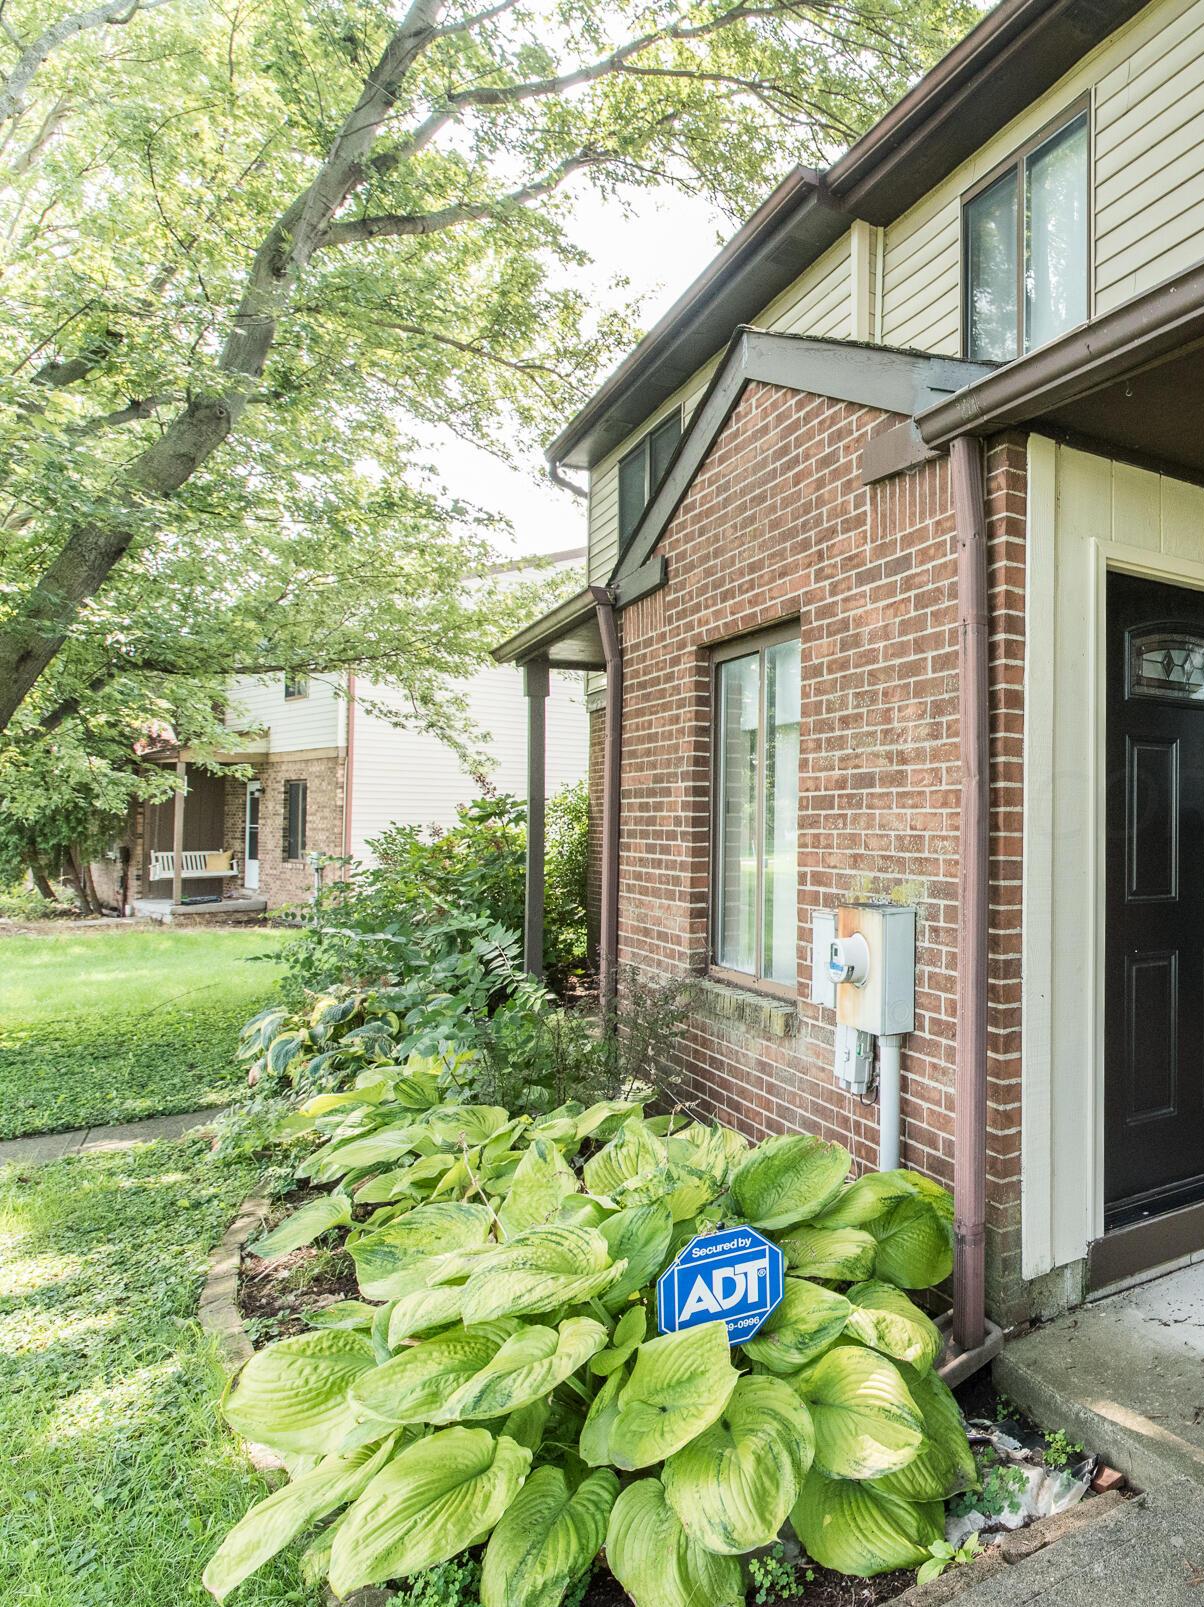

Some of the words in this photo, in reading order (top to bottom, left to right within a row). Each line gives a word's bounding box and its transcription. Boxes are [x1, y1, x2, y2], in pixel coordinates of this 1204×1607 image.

[692, 1239, 737, 1258] Secured
[738, 1238, 752, 1248] by
[678, 1258, 768, 1322] ADT
